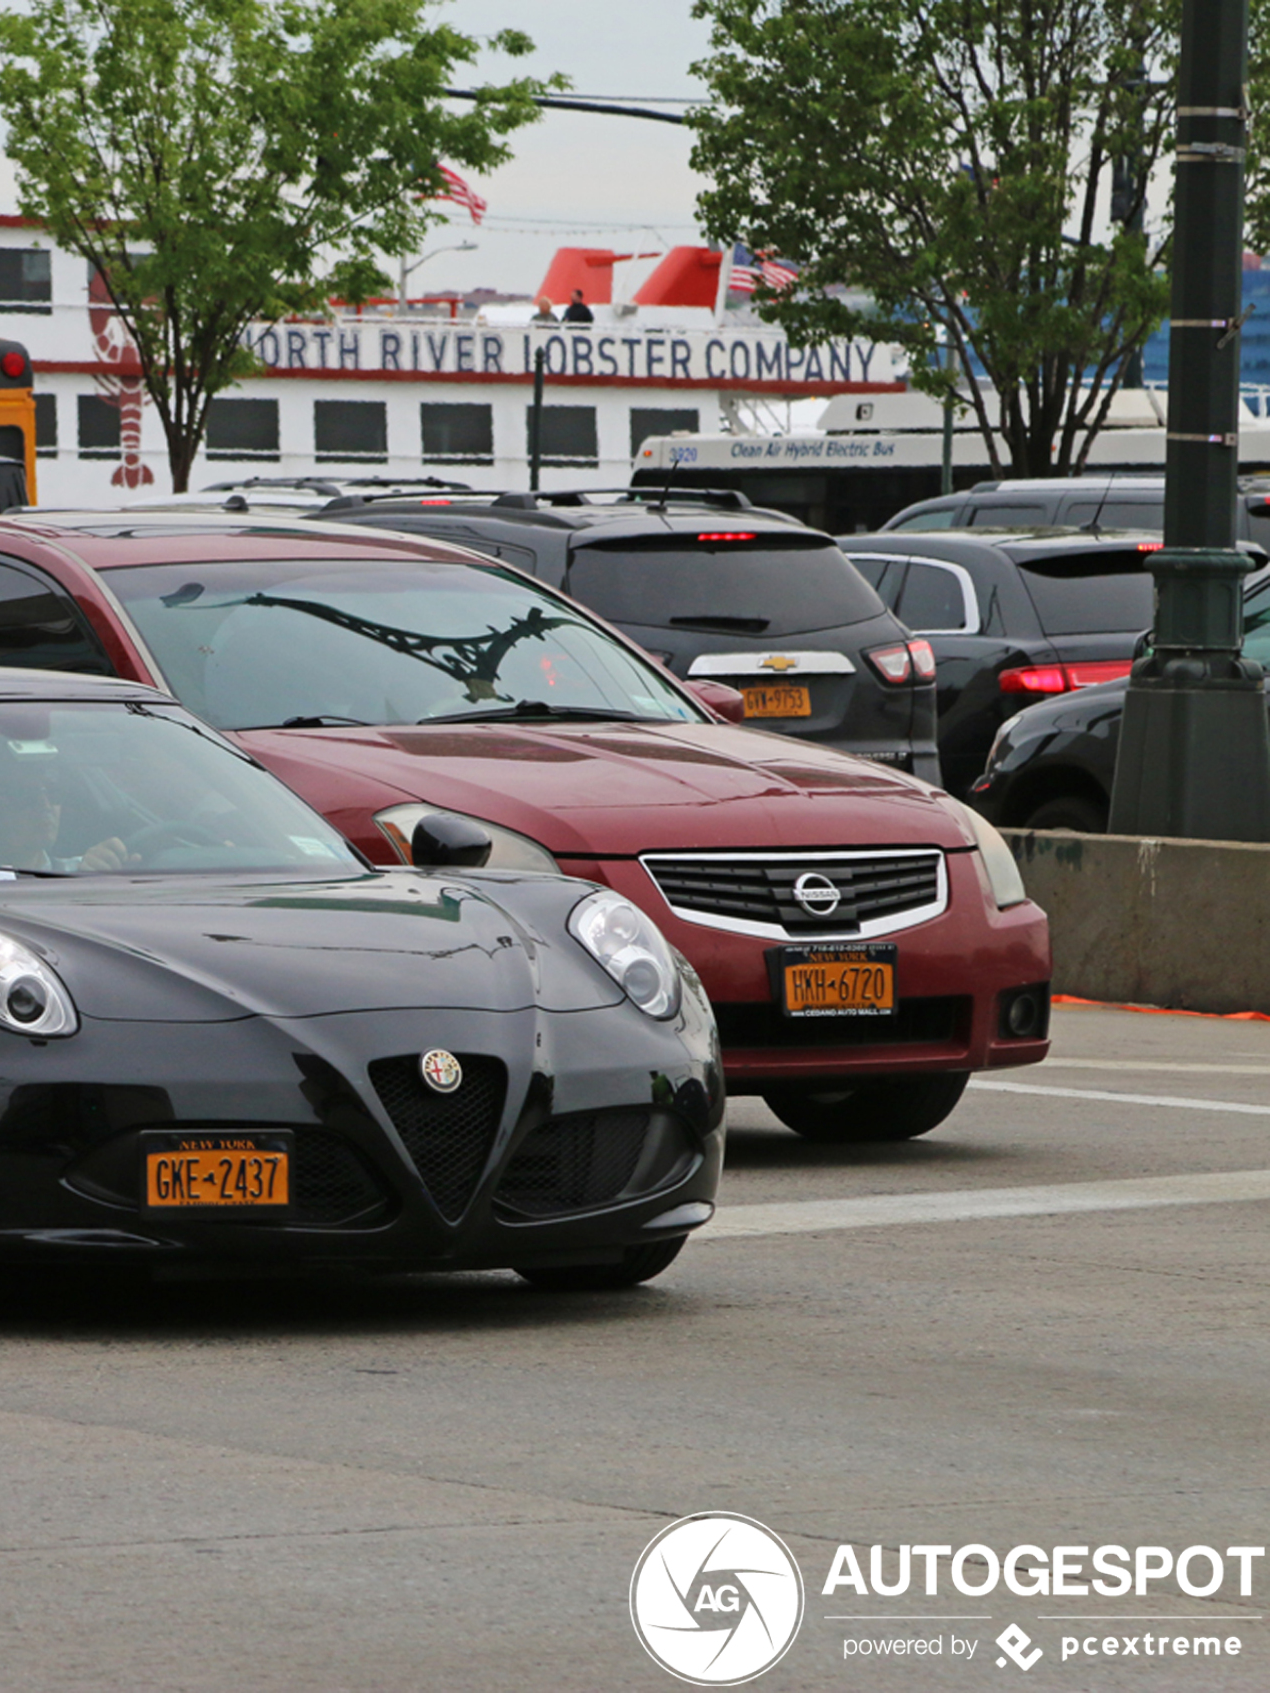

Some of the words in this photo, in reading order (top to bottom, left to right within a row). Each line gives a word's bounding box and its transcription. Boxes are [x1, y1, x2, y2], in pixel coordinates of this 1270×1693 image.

[381, 333, 503, 373] RIVER
[523, 334, 692, 378] LOBSTER
[705, 339, 877, 382] COMPANY
[731, 442, 763, 458] Clean
[764, 442, 780, 458] Air
[785, 441, 825, 462] Hybrid
[826, 441, 869, 458] Electric
[873, 441, 895, 457] Bus
[774, 689, 803, 709] 9753
[801, 890, 838, 899] NISSAN
[809, 952, 836, 962] NEW
[838, 952, 868, 962] YORK
[792, 968, 827, 1002] HKH
[838, 967, 885, 1001] 6720
[858, 1008, 879, 1016] MALL
[179, 1139, 214, 1150] NEW
[219, 1139, 256, 1150] YORK
[156, 1157, 201, 1200] GKE
[219, 1157, 280, 1199] 2437
